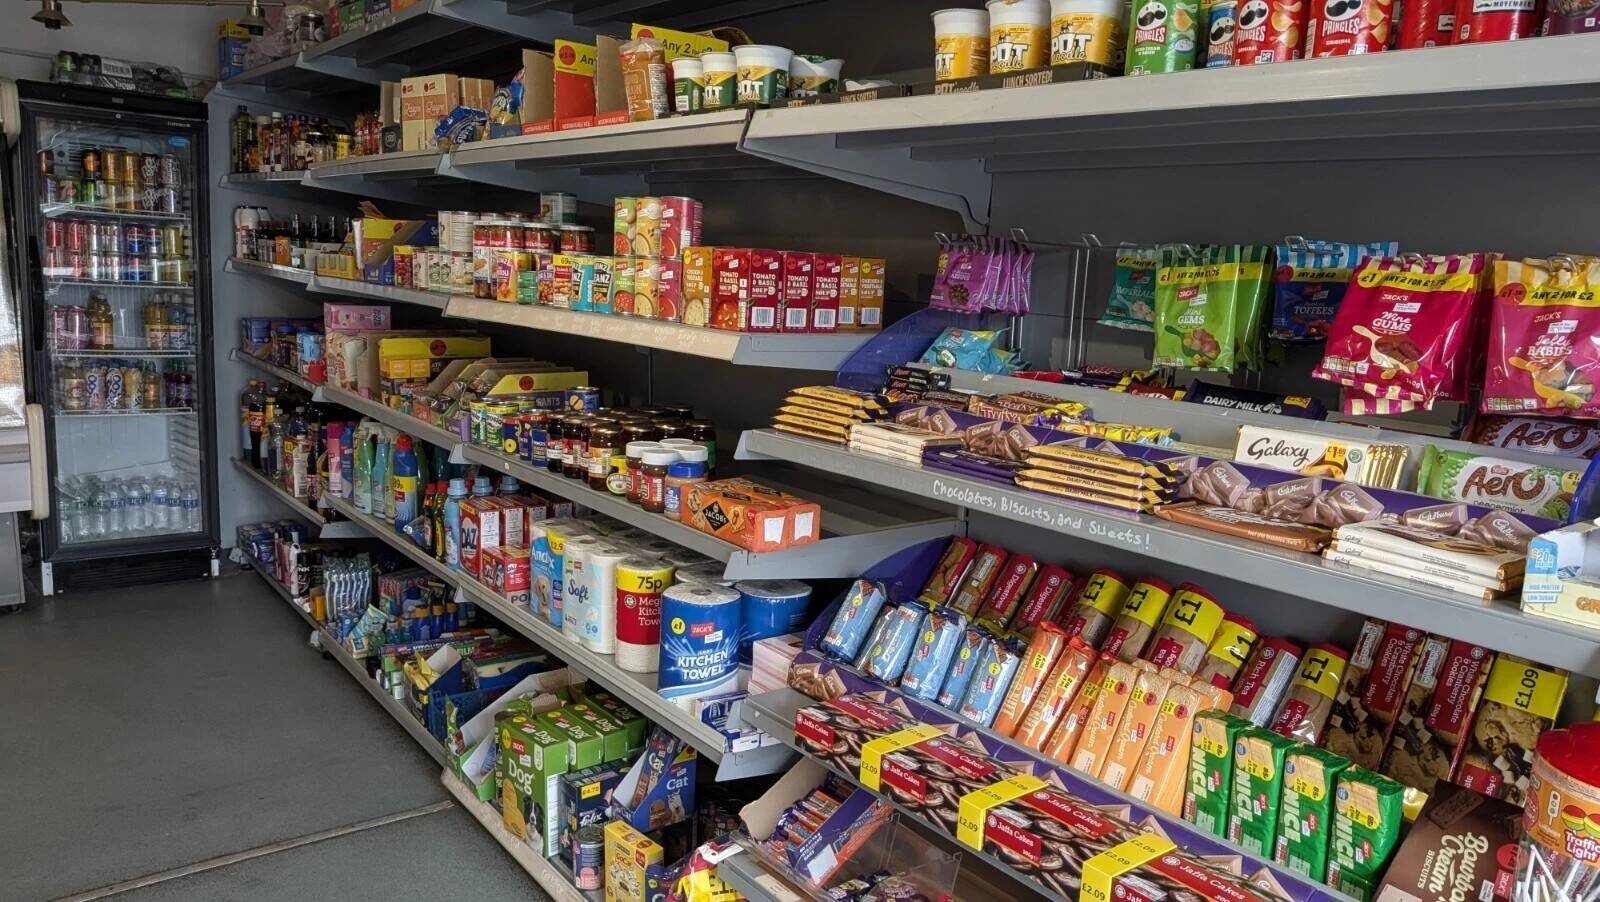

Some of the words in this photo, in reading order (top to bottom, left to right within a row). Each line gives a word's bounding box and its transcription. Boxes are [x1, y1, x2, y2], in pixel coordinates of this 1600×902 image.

[1134, 26, 1166, 45] PRINGLES
[1236, 26, 1266, 44] PRINGLES
[1322, 18, 1360, 37] PRINGLES
[662, 39, 682, 55] Any
[684, 44, 692, 54] 2
[990, 42, 1029, 64] POT
[935, 52, 955, 72] OT
[1003, 74, 1024, 89] LUNCH
[719, 270, 739, 279] TOMATO
[752, 273, 776, 281] TOMATO
[815, 276, 838, 284] TOMATO
[1160, 272, 1171, 282] £1
[1360, 273, 1377, 284] £1
[1383, 273, 1399, 284] ANY
[1400, 276, 1407, 285] 2
[1407, 278, 1422, 287] FOR
[1381, 294, 1409, 302] JACK'S
[1531, 291, 1551, 300] ANY
[1550, 291, 1560, 300] 2
[1560, 290, 1578, 300] FOR
[1577, 291, 1595, 301] £2
[1177, 315, 1206, 325] GEMS
[1372, 318, 1413, 332] GUMS
[1381, 311, 1412, 324] Wine
[1534, 311, 1562, 323] JACK'S
[1535, 334, 1572, 347] Jelly
[1203, 395, 1237, 408] DAIRY
[1236, 401, 1265, 413] MILK
[1247, 437, 1312, 468] Galaxy
[933, 479, 996, 509] Chocolates,
[1057, 513, 1082, 530] and
[461, 527, 477, 550] DAZ
[568, 578, 589, 604] Soft
[637, 576, 663, 593] 75p
[995, 574, 1019, 609] Digestives
[1083, 579, 1104, 603] £1
[639, 597, 660, 610] Meg
[1028, 586, 1053, 622] Digestives
[1125, 588, 1146, 614] £1
[638, 617, 660, 627] Tow
[1174, 599, 1202, 628] £1
[673, 622, 684, 633] £1
[690, 624, 714, 635] JACK'S
[677, 649, 729, 668] KITCHEN
[1153, 648, 1167, 665] Tea
[1380, 637, 1398, 668] Cookies
[1401, 642, 1414, 665] White
[682, 664, 726, 682] TOWEL
[1251, 659, 1267, 683] Rich
[1301, 656, 1330, 684] £1
[1382, 647, 1402, 685] Cranberry
[1445, 655, 1463, 687] Cookies
[1466, 660, 1480, 684] White
[1241, 679, 1255, 697] Tea
[1384, 664, 1404, 703] Chocolate
[1447, 664, 1469, 705] Cranberry
[1515, 667, 1540, 710] £1.09
[1450, 683, 1470, 724] Chocolate
[569, 725, 598, 739] Dog
[595, 717, 621, 732] Dog
[802, 718, 815, 731] Jaffa
[814, 723, 829, 738] Cakes
[534, 730, 560, 744] Dog
[938, 745, 961, 760] Jaffa
[959, 754, 985, 770] Cakes
[508, 758, 535, 796] Dog
[861, 761, 878, 775] £2.09
[889, 764, 902, 777] Jaffa
[902, 769, 920, 787] Cakes
[1191, 746, 1207, 798] NICE
[666, 776, 689, 791] Cat
[1235, 768, 1253, 822] NICE
[1046, 797, 1075, 816] Jaffa
[1074, 809, 1103, 828] Cakes
[1283, 787, 1301, 843] NICE
[959, 815, 979, 833] £2.09
[997, 819, 1014, 836] Jaffa
[1013, 827, 1035, 847] Cakes
[1130, 839, 1157, 854] £2.09
[1335, 812, 1355, 869] NICE
[1104, 851, 1131, 866] £2.09
[1567, 845, 1600, 861] Light
[1417, 849, 1435, 889] BISCUITS
[1429, 834, 1465, 893] Cream
[1081, 882, 1106, 902] £2.09
[1179, 864, 1208, 882] Jaffa
[1209, 879, 1246, 901] Cakes
